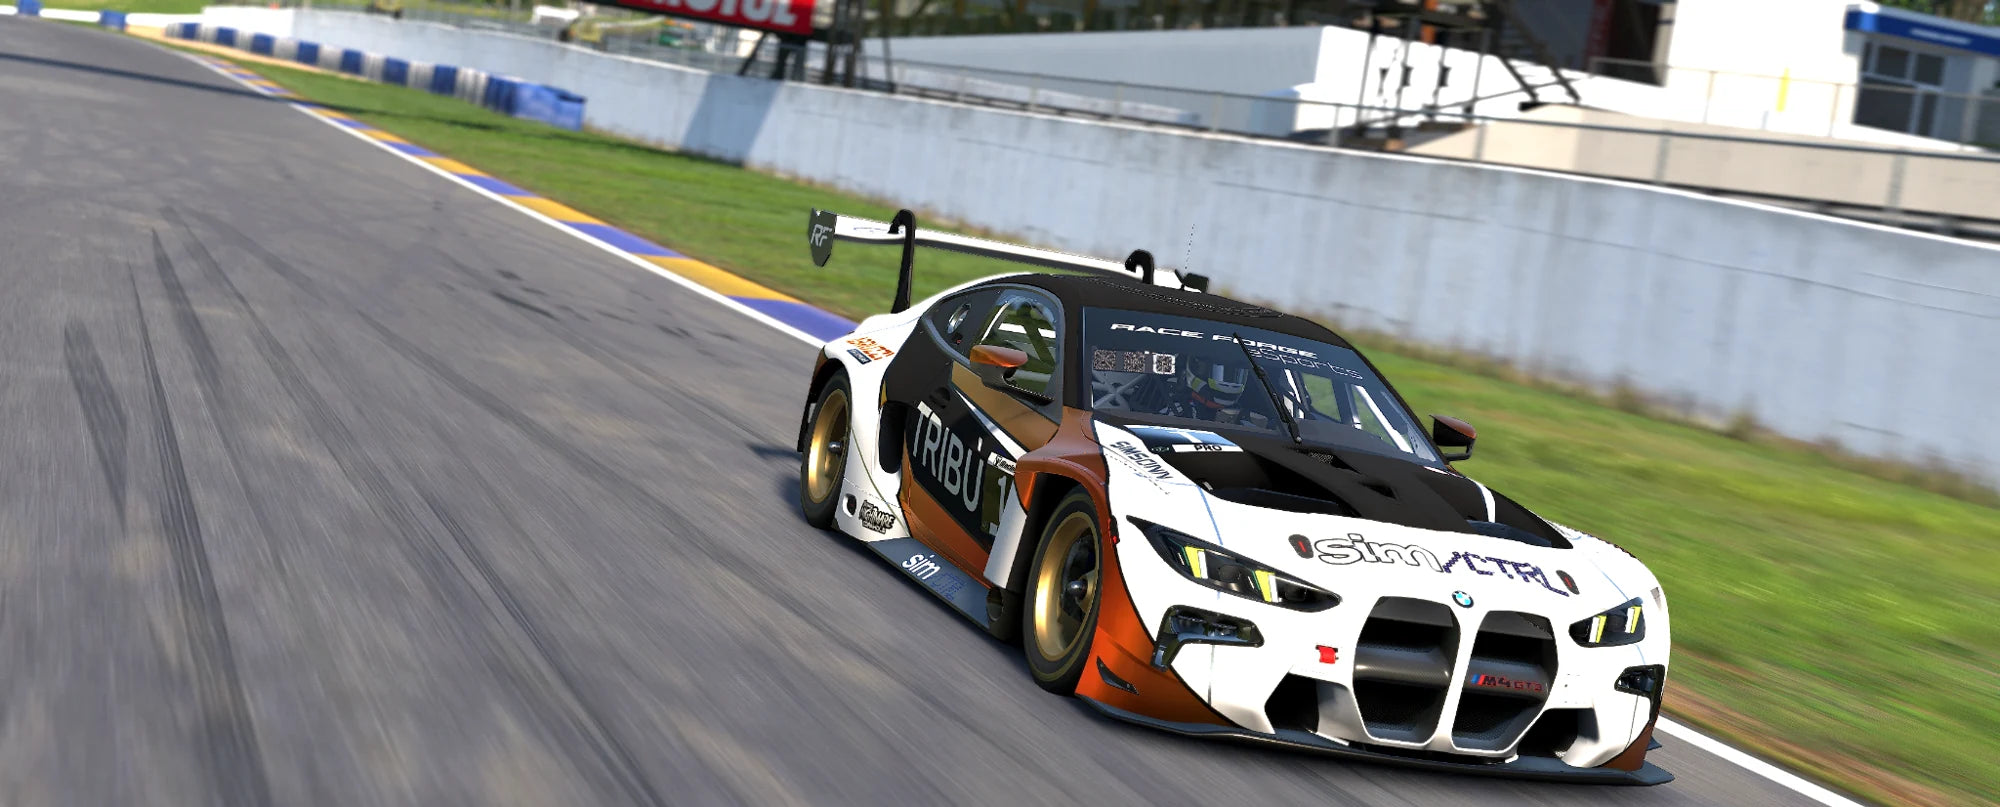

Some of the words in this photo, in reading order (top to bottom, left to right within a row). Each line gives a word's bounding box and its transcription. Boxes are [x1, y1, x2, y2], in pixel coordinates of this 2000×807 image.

[652, 0, 798, 27] TUL
[810, 223, 833, 248] RF
[1110, 323, 1205, 339] RACE
[1212, 334, 1319, 360] FORGE
[1193, 443, 1223, 452] PRO
